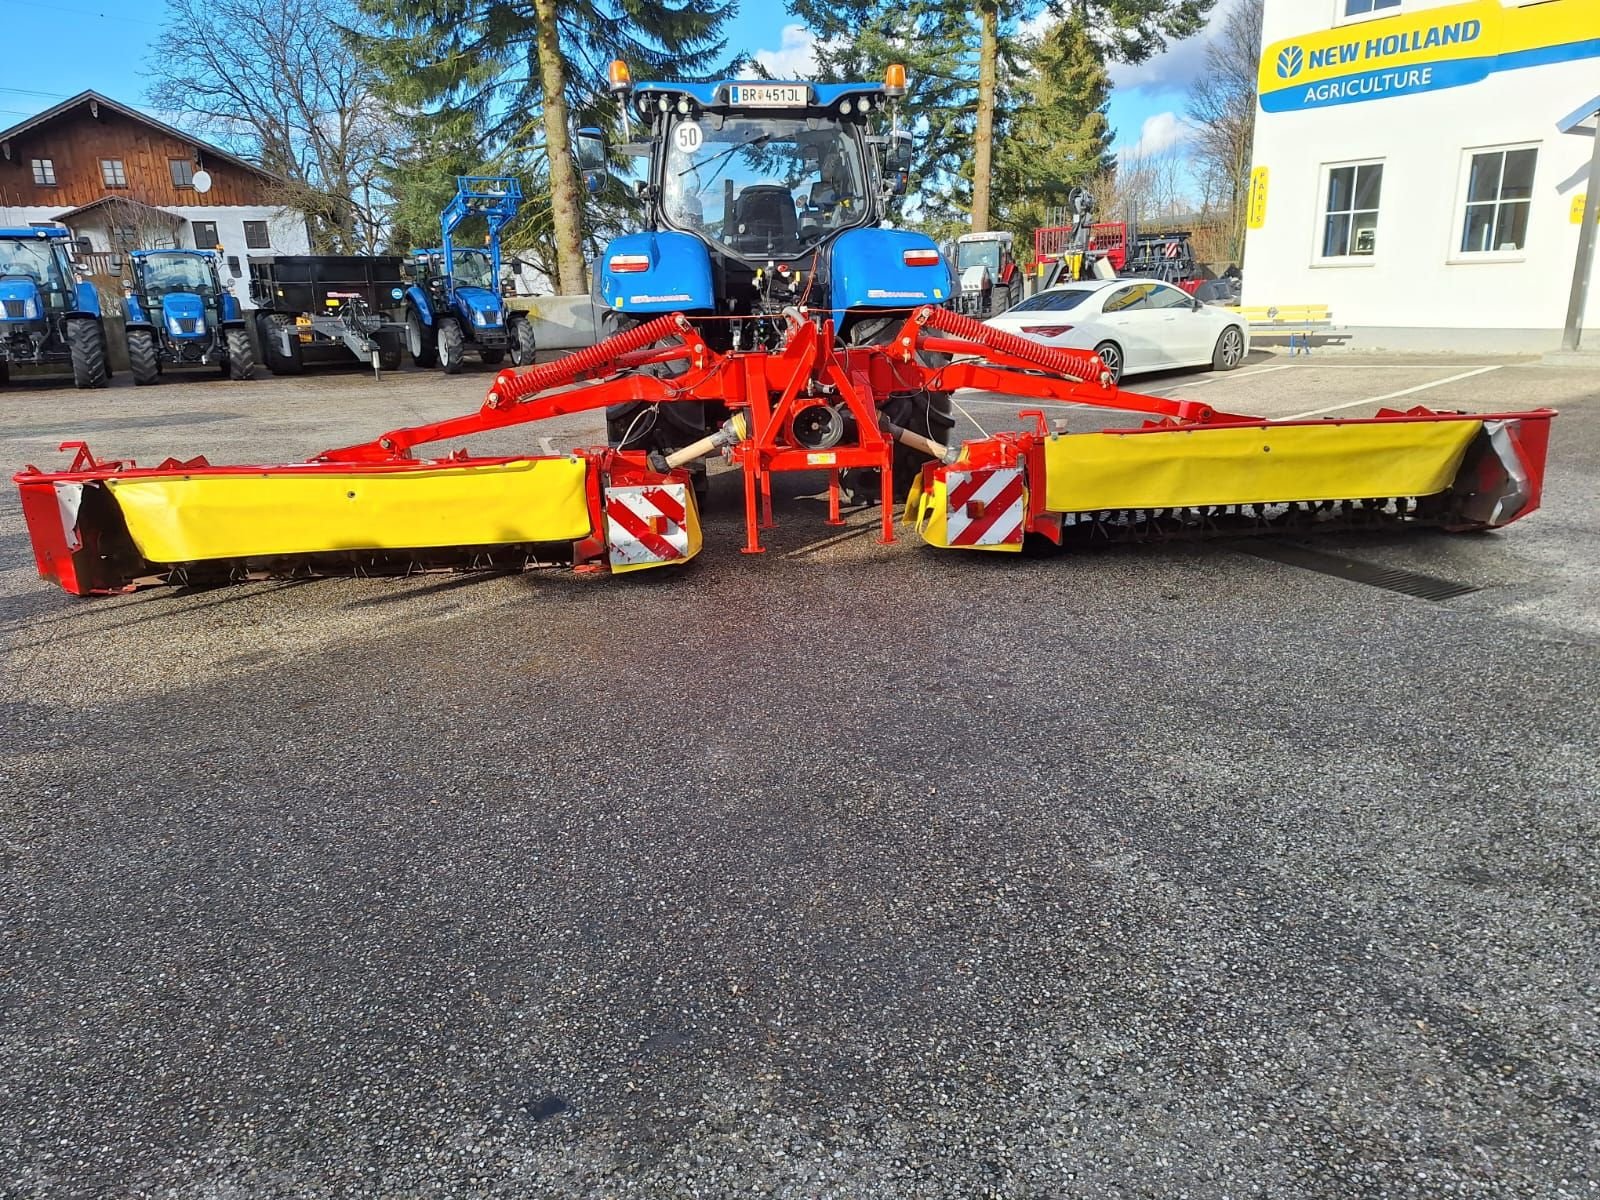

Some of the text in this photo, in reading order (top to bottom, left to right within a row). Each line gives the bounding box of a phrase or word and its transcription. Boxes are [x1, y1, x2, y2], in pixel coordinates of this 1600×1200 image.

[1308, 19, 1481, 69] NEW HOLLAND
[742, 88, 801, 102] BR 451JL
[1304, 67, 1433, 103] AGRICULTURE
[679, 127, 697, 147] 50
